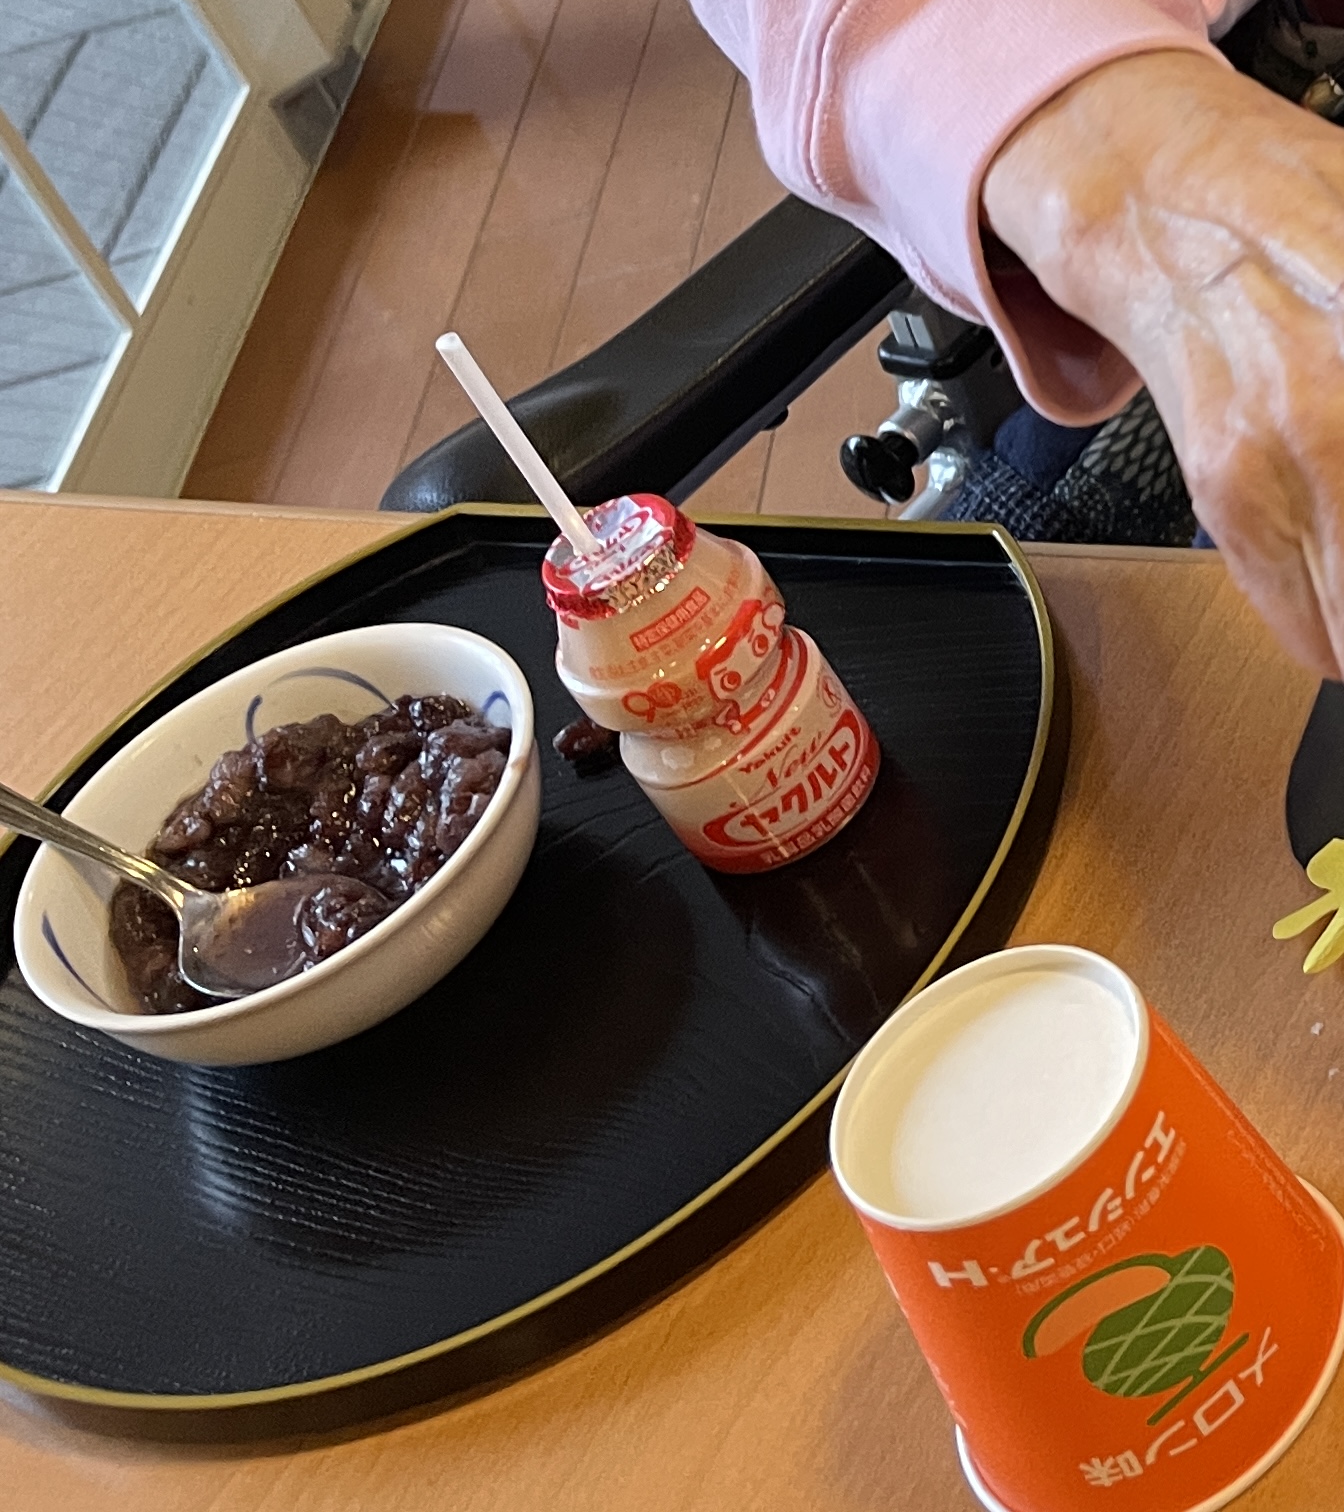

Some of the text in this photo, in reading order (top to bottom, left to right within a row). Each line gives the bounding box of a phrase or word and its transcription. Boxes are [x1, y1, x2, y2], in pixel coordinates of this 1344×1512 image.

[738, 727, 802, 774] Yakult
[740, 741, 850, 838] ヤクルト
[1078, 1326, 1279, 1487] メロン味
